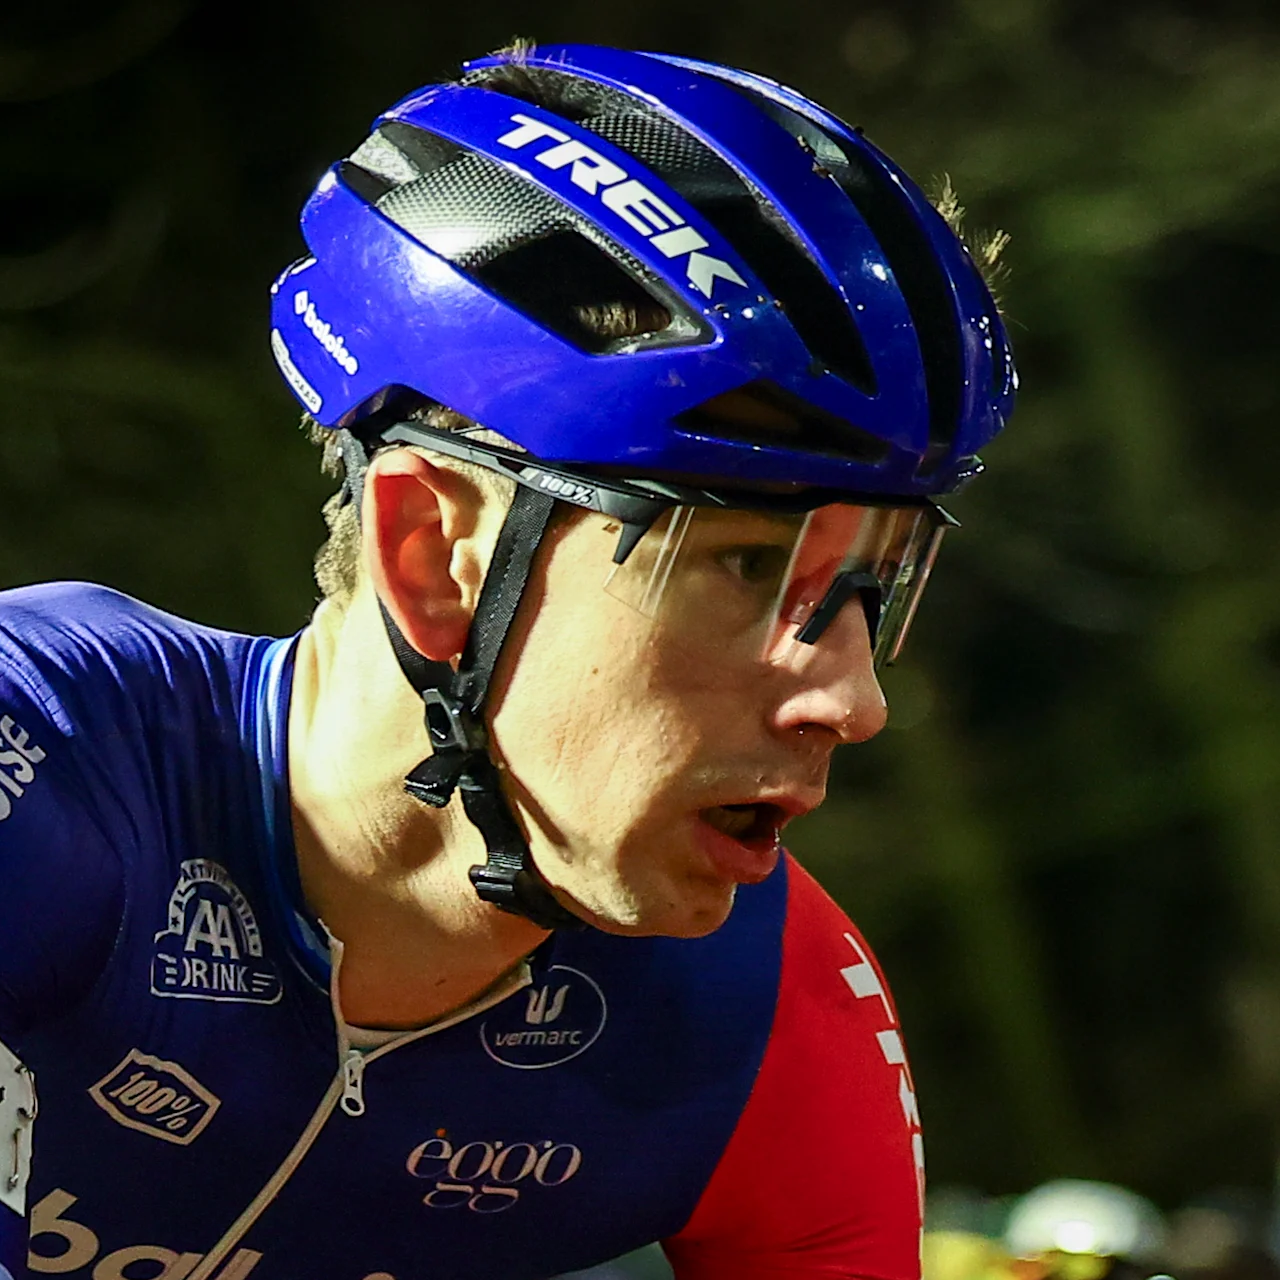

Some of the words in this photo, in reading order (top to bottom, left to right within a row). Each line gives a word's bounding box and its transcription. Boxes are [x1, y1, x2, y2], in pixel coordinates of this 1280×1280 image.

[497, 113, 747, 299] TREK
[303, 302, 358, 375] baloise
[540, 475, 592, 503] 100%
[184, 899, 240, 960] AA
[495, 1027, 582, 1048] vermarc
[109, 1072, 201, 1131] 100%
